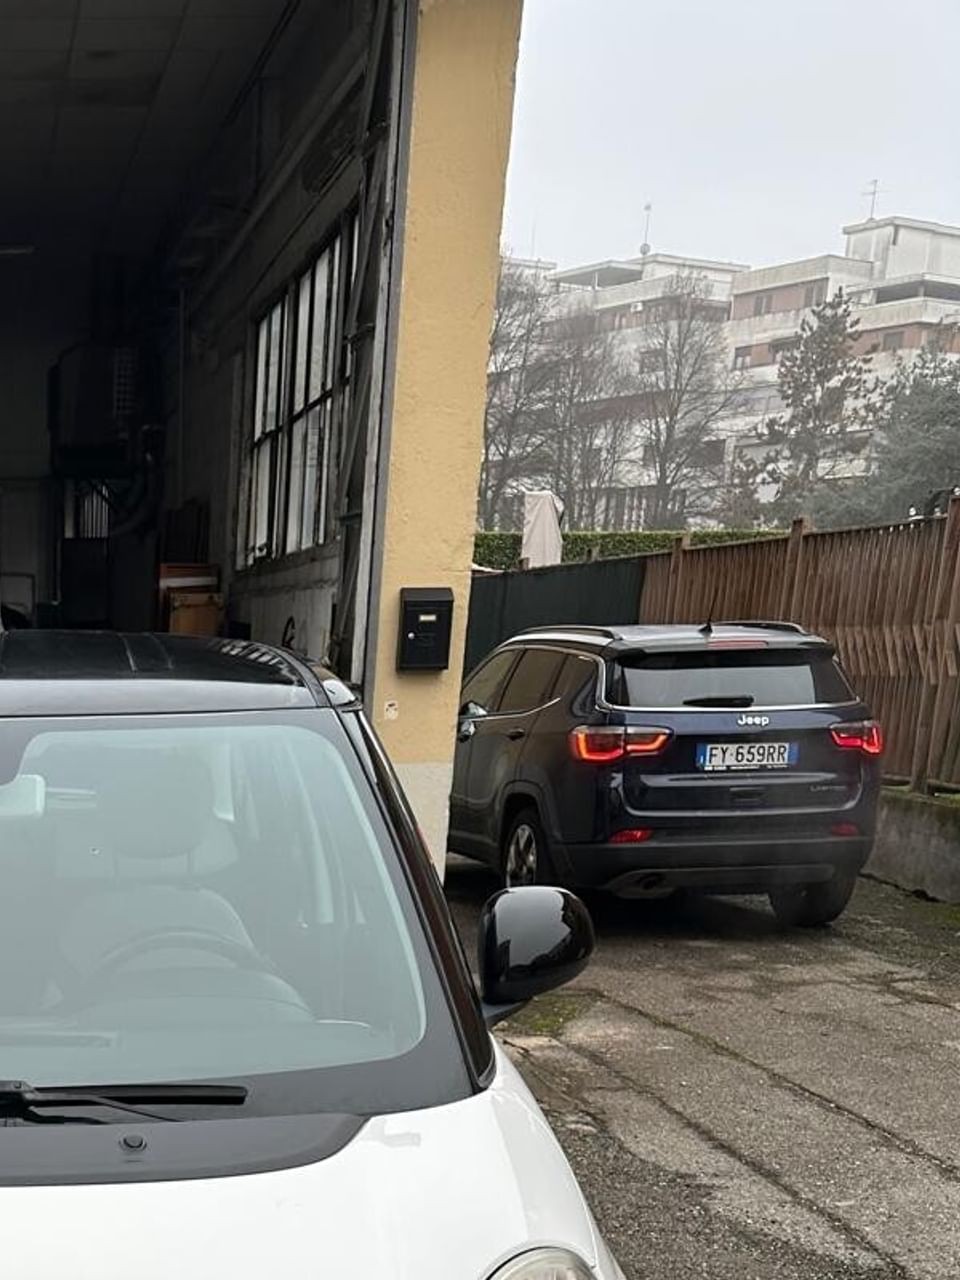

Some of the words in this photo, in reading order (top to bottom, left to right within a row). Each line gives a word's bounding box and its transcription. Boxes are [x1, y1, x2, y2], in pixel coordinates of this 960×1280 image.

[737, 714, 770, 726] Jeep
[709, 746, 728, 764] FY
[735, 745, 787, 763] 659RR
